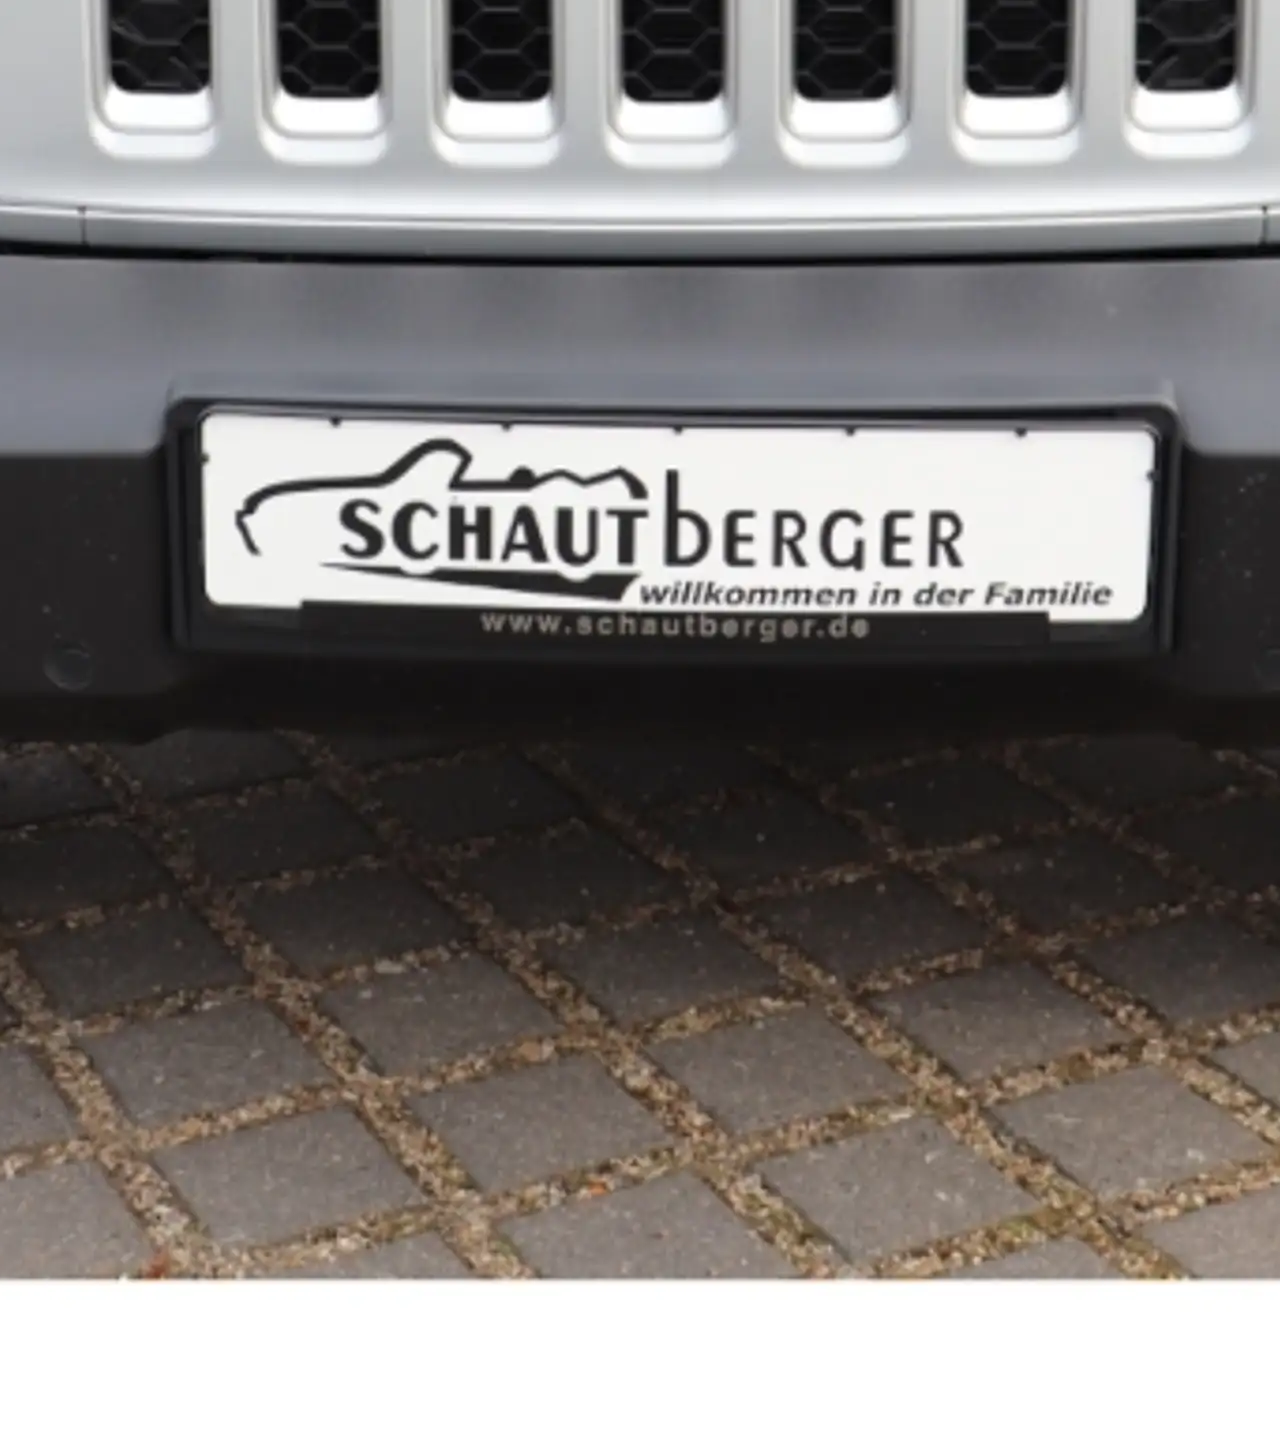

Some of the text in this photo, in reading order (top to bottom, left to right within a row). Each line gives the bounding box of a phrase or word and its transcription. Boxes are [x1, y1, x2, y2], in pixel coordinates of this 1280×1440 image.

[640, 580, 1114, 607] willkommen in der Familie
[480, 610, 870, 643] www.schautberger.de
